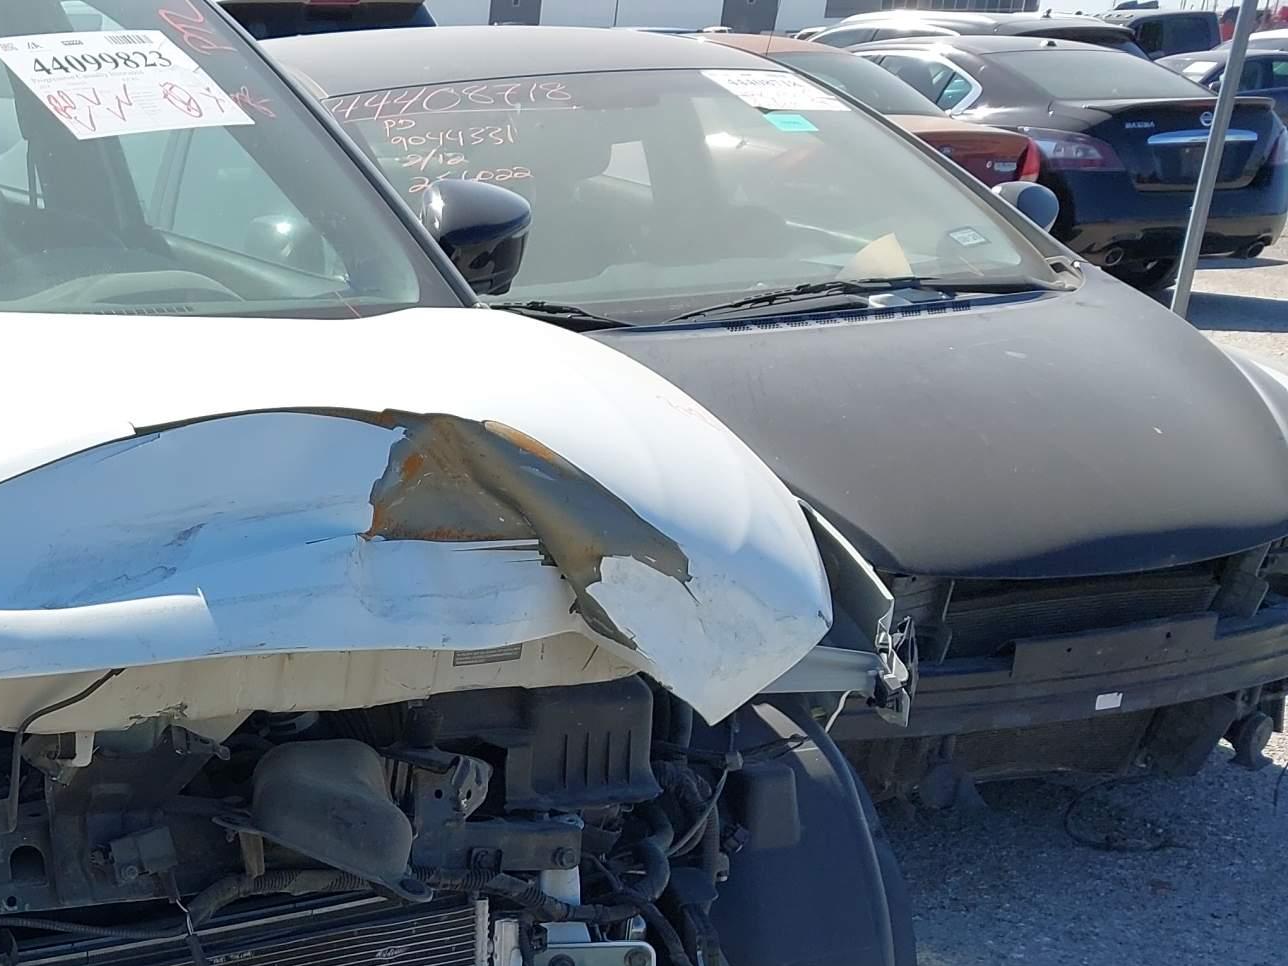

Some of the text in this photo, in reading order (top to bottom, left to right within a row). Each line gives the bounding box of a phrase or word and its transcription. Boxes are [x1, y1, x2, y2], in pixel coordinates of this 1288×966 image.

[33, 50, 172, 74] 44099823
[331, 82, 572, 120] 44408718
[391, 124, 514, 151] 9044331
